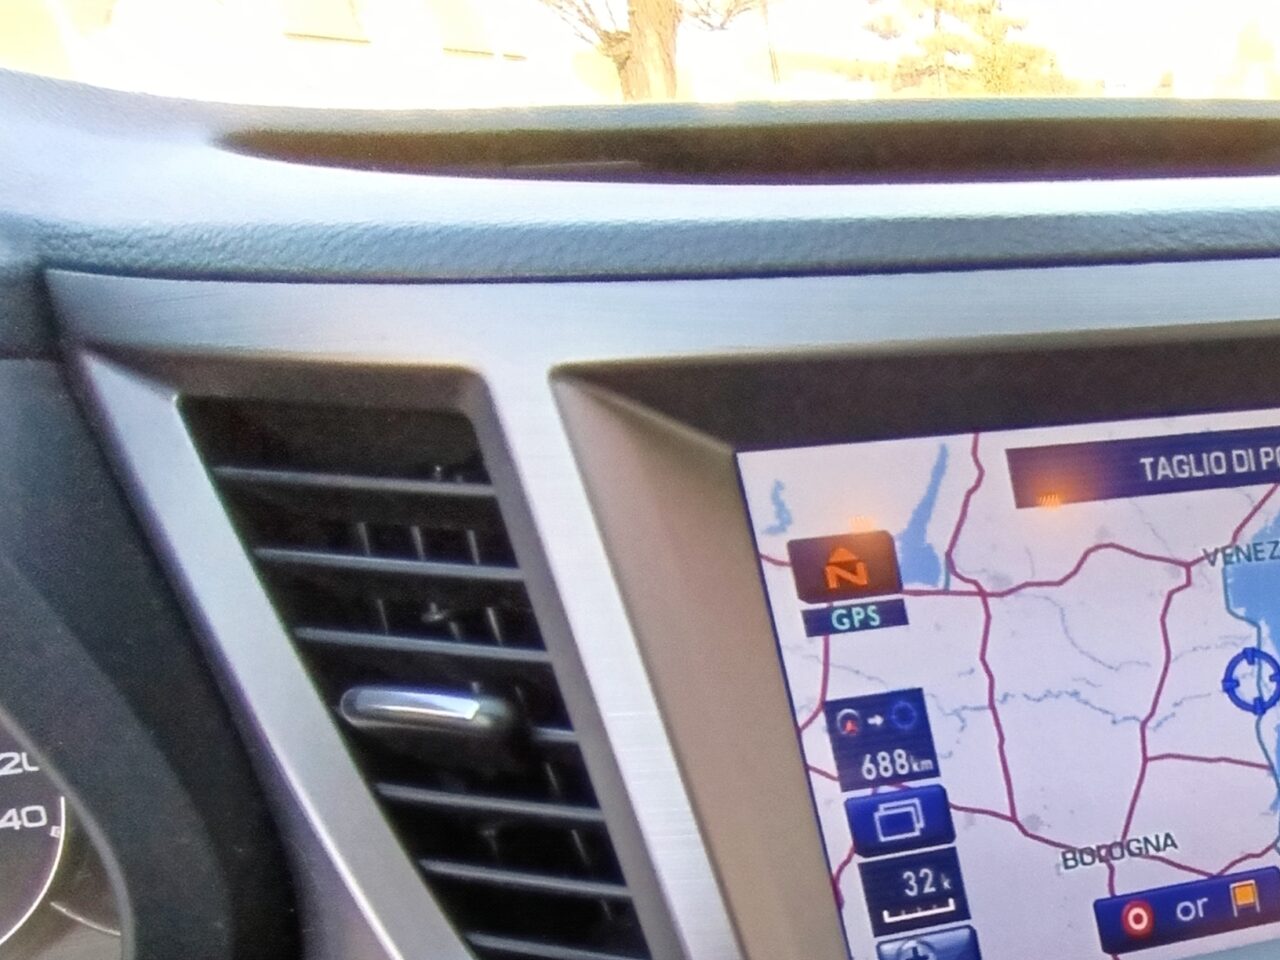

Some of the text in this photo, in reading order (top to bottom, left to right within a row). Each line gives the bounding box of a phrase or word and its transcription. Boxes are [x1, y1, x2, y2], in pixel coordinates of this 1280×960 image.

[1140, 451, 1226, 481] TAGLIO
[1232, 448, 1256, 473] DI
[831, 606, 880, 630] GPS
[1061, 832, 1178, 870] BOLOGNA
[903, 868, 936, 896] 32
[1176, 897, 1208, 921] or
